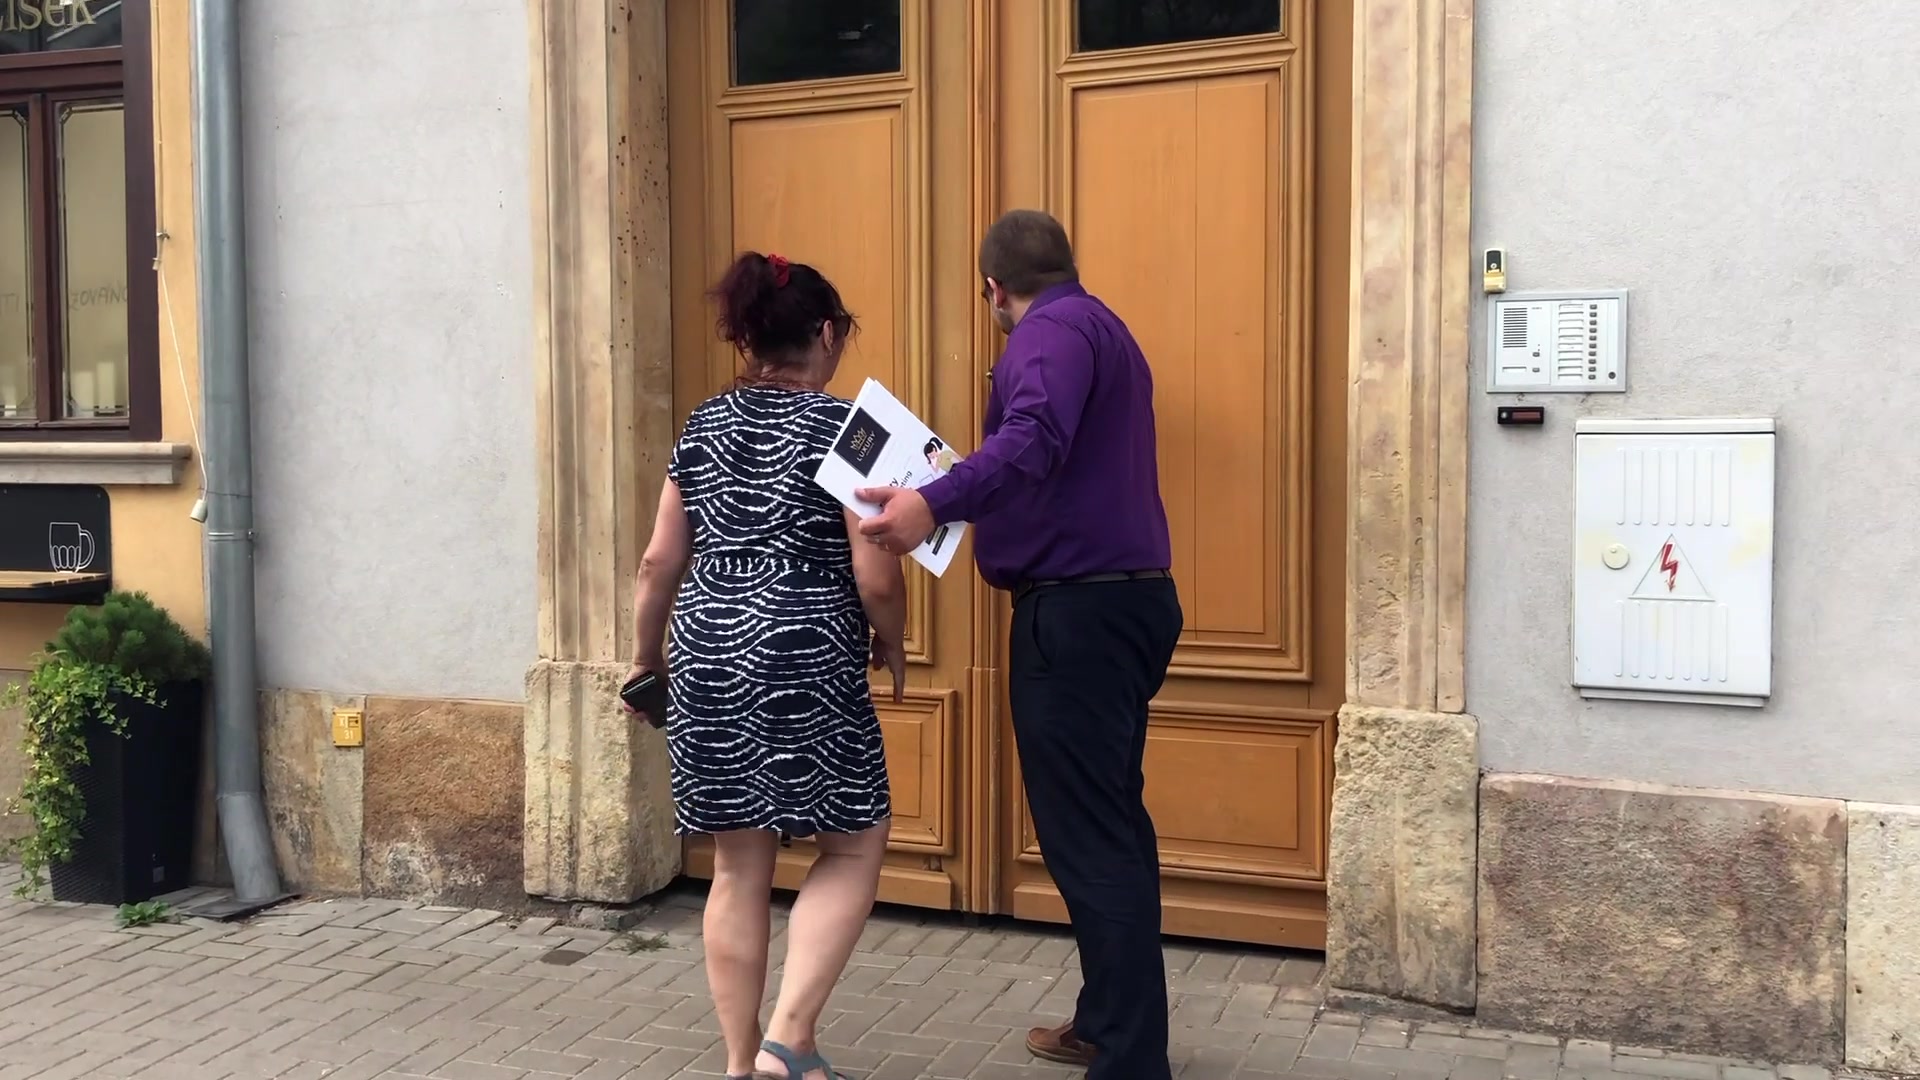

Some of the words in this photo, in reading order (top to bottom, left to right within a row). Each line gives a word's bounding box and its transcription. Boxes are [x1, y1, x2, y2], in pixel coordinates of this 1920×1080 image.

[856, 431, 875, 462] LUXURY
[900, 470, 913, 488] ting
[344, 730, 354, 740] 31
